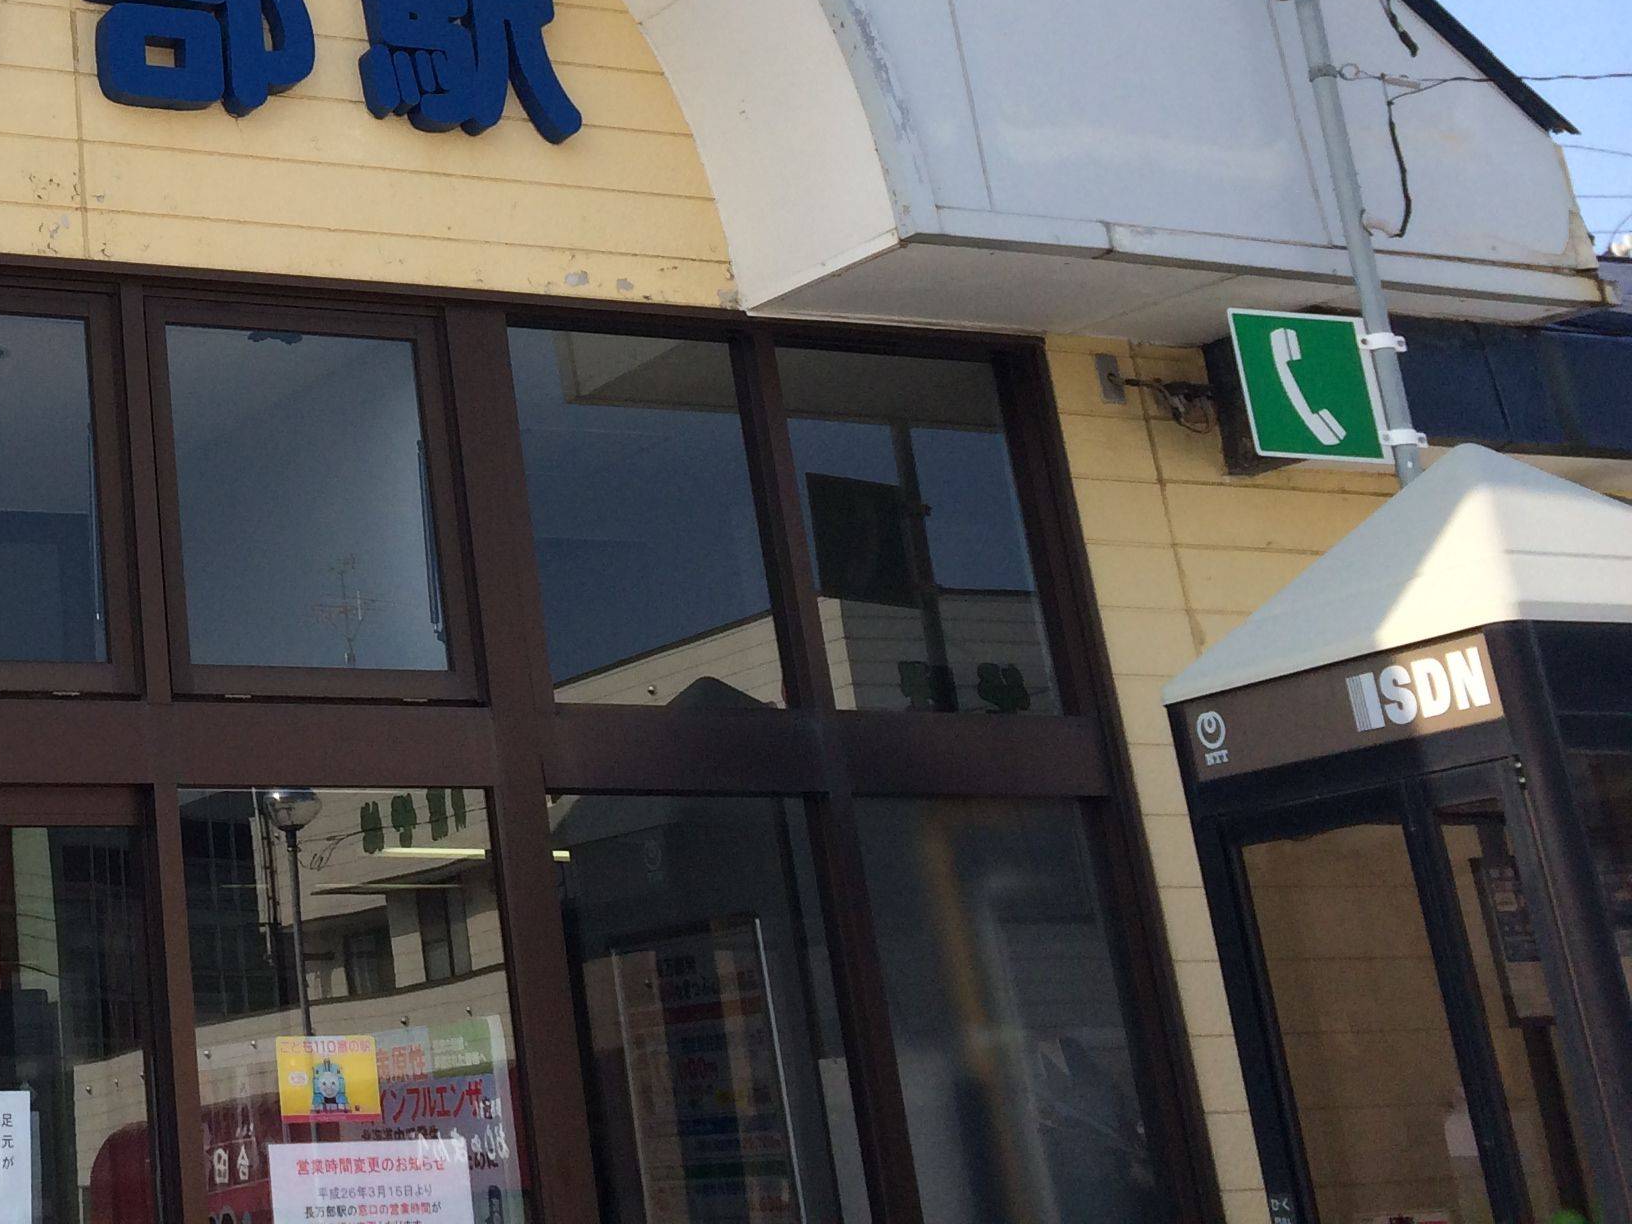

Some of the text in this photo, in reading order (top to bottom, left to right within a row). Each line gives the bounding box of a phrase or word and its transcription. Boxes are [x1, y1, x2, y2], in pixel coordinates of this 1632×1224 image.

[1345, 646, 1491, 732] ISDN
[1204, 749, 1229, 765] NTT
[1, 1113, 15, 1170] 足元が
[296, 1156, 445, 1175] 営業時間変更のお知らせ
[318, 1182, 432, 1200] 平成26年3月15日より
[304, 1201, 442, 1219] 長万部駅の窓口の営業時間が
